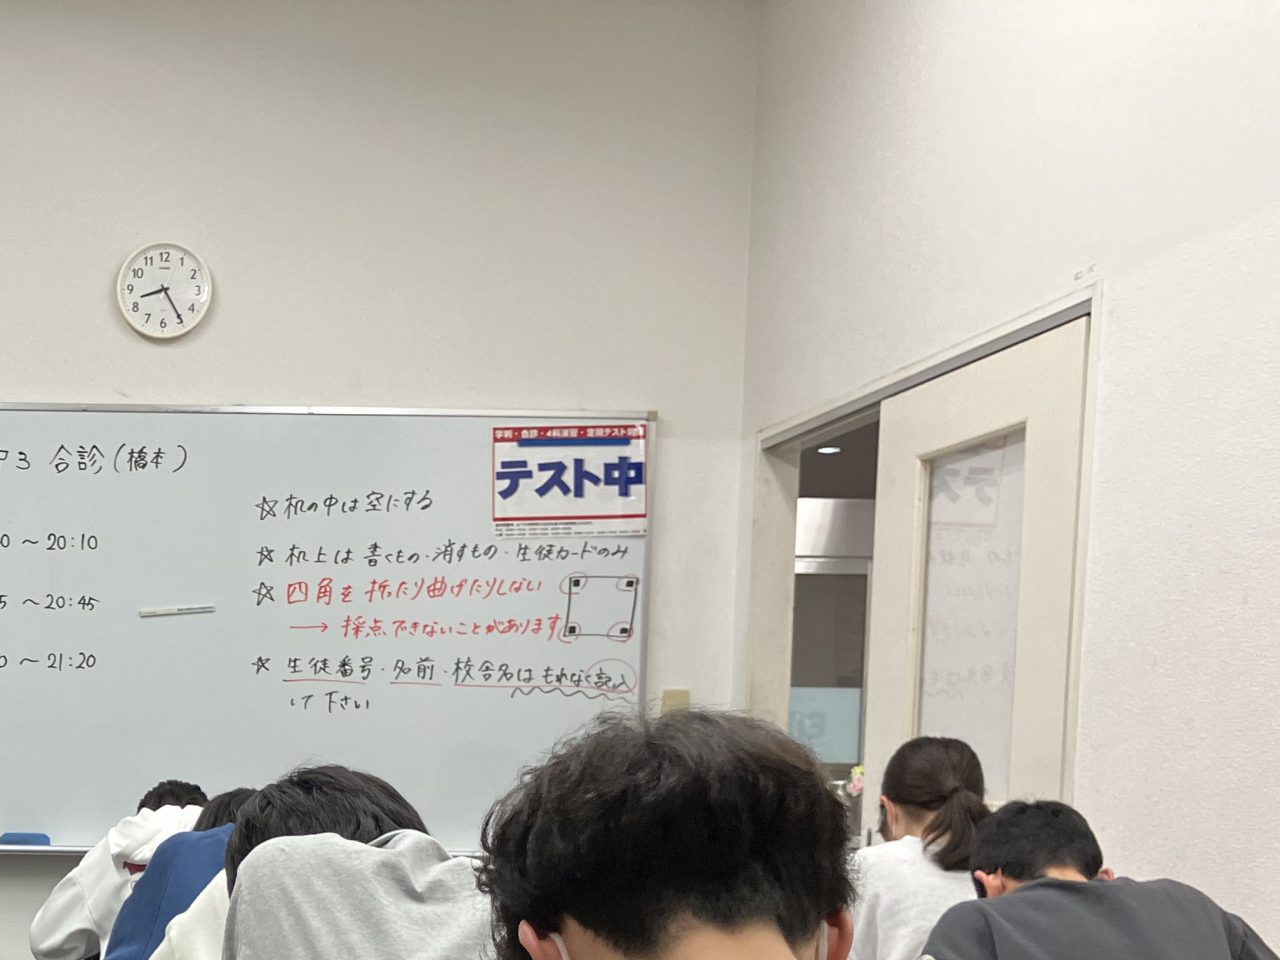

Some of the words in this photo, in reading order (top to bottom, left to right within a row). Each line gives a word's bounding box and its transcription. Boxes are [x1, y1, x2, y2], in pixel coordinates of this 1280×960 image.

[144, 256, 153, 266] 11
[159, 252, 170, 262] 12
[179, 256, 184, 266] 1
[132, 268, 144, 278] 10
[190, 269, 197, 279] 2
[127, 284, 134, 294] 9
[194, 285, 201, 296] 3
[132, 302, 139, 312] 8
[188, 303, 195, 313] 4
[145, 313, 151, 324] 7
[160, 318, 167, 328] 6
[495, 456, 645, 500] テスト中
